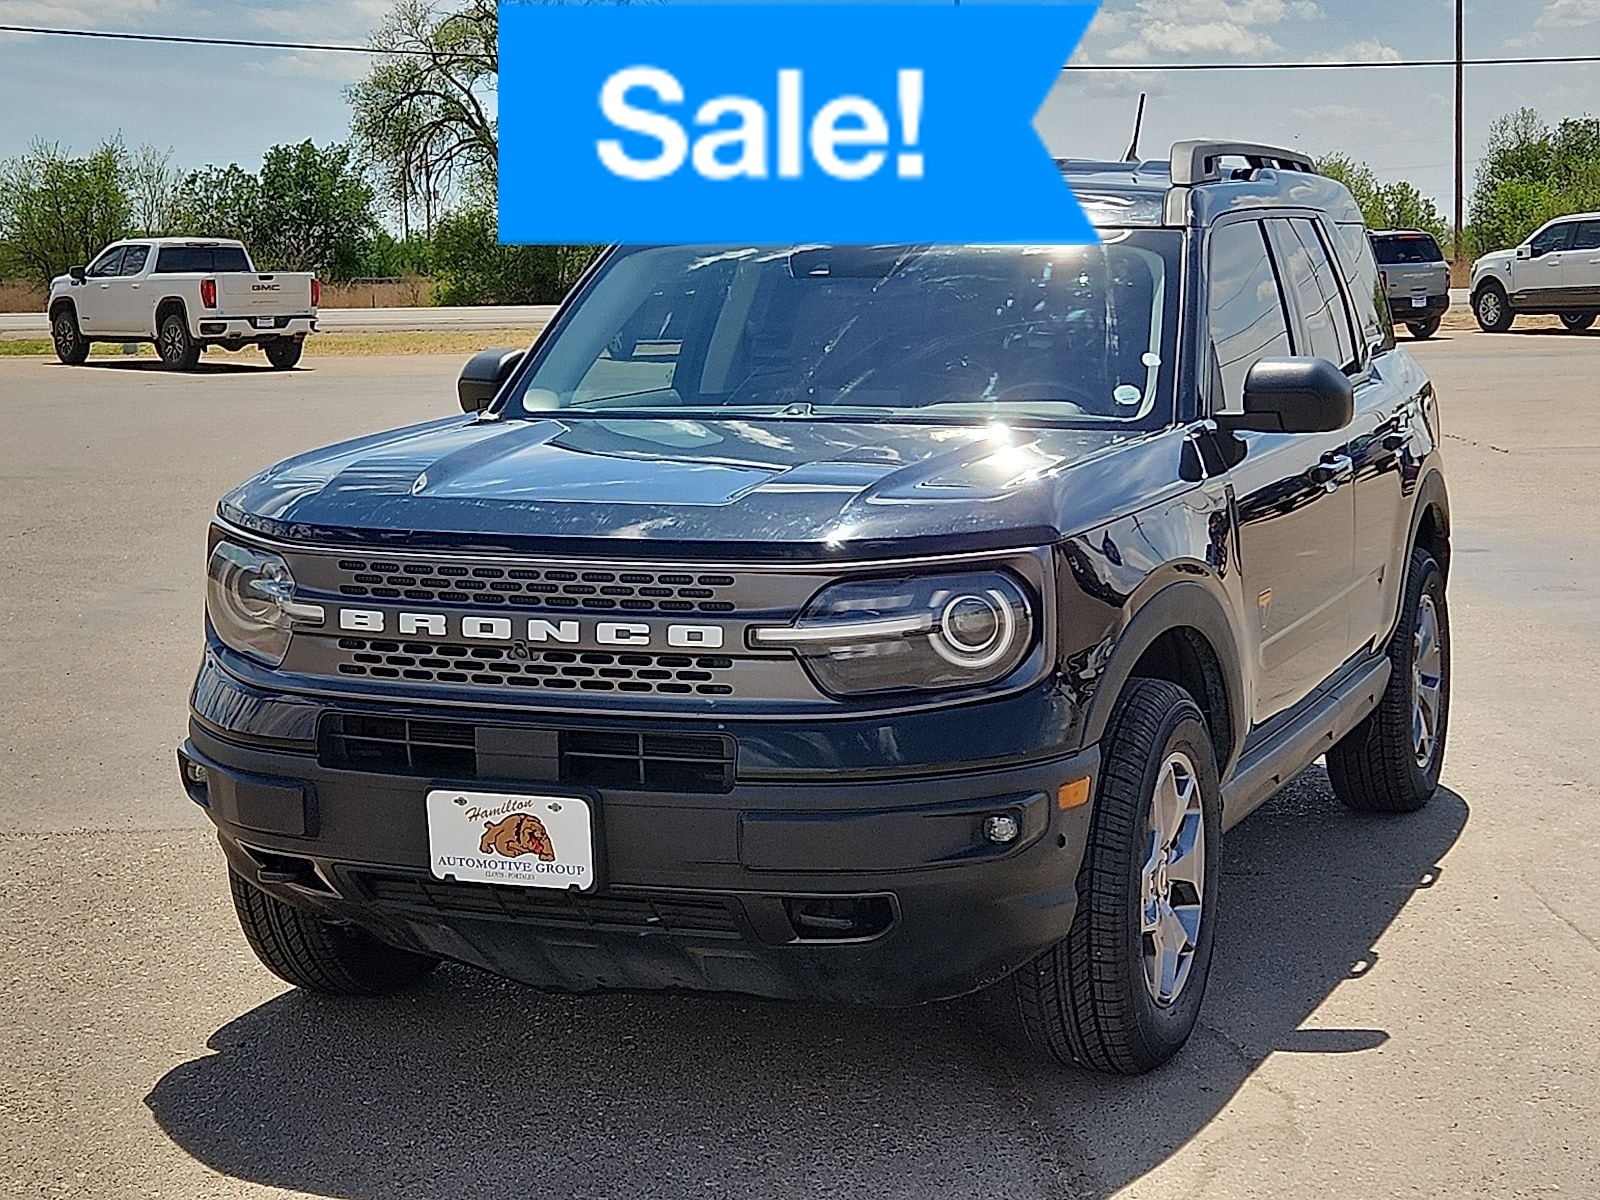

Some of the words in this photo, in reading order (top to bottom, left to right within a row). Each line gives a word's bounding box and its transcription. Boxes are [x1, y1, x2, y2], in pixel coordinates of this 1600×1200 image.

[339, 607, 724, 648] BRONCO
[465, 799, 534, 822] Hamilton
[438, 856, 532, 872] AUTOMOTIVE
[535, 863, 585, 876] GROUP
